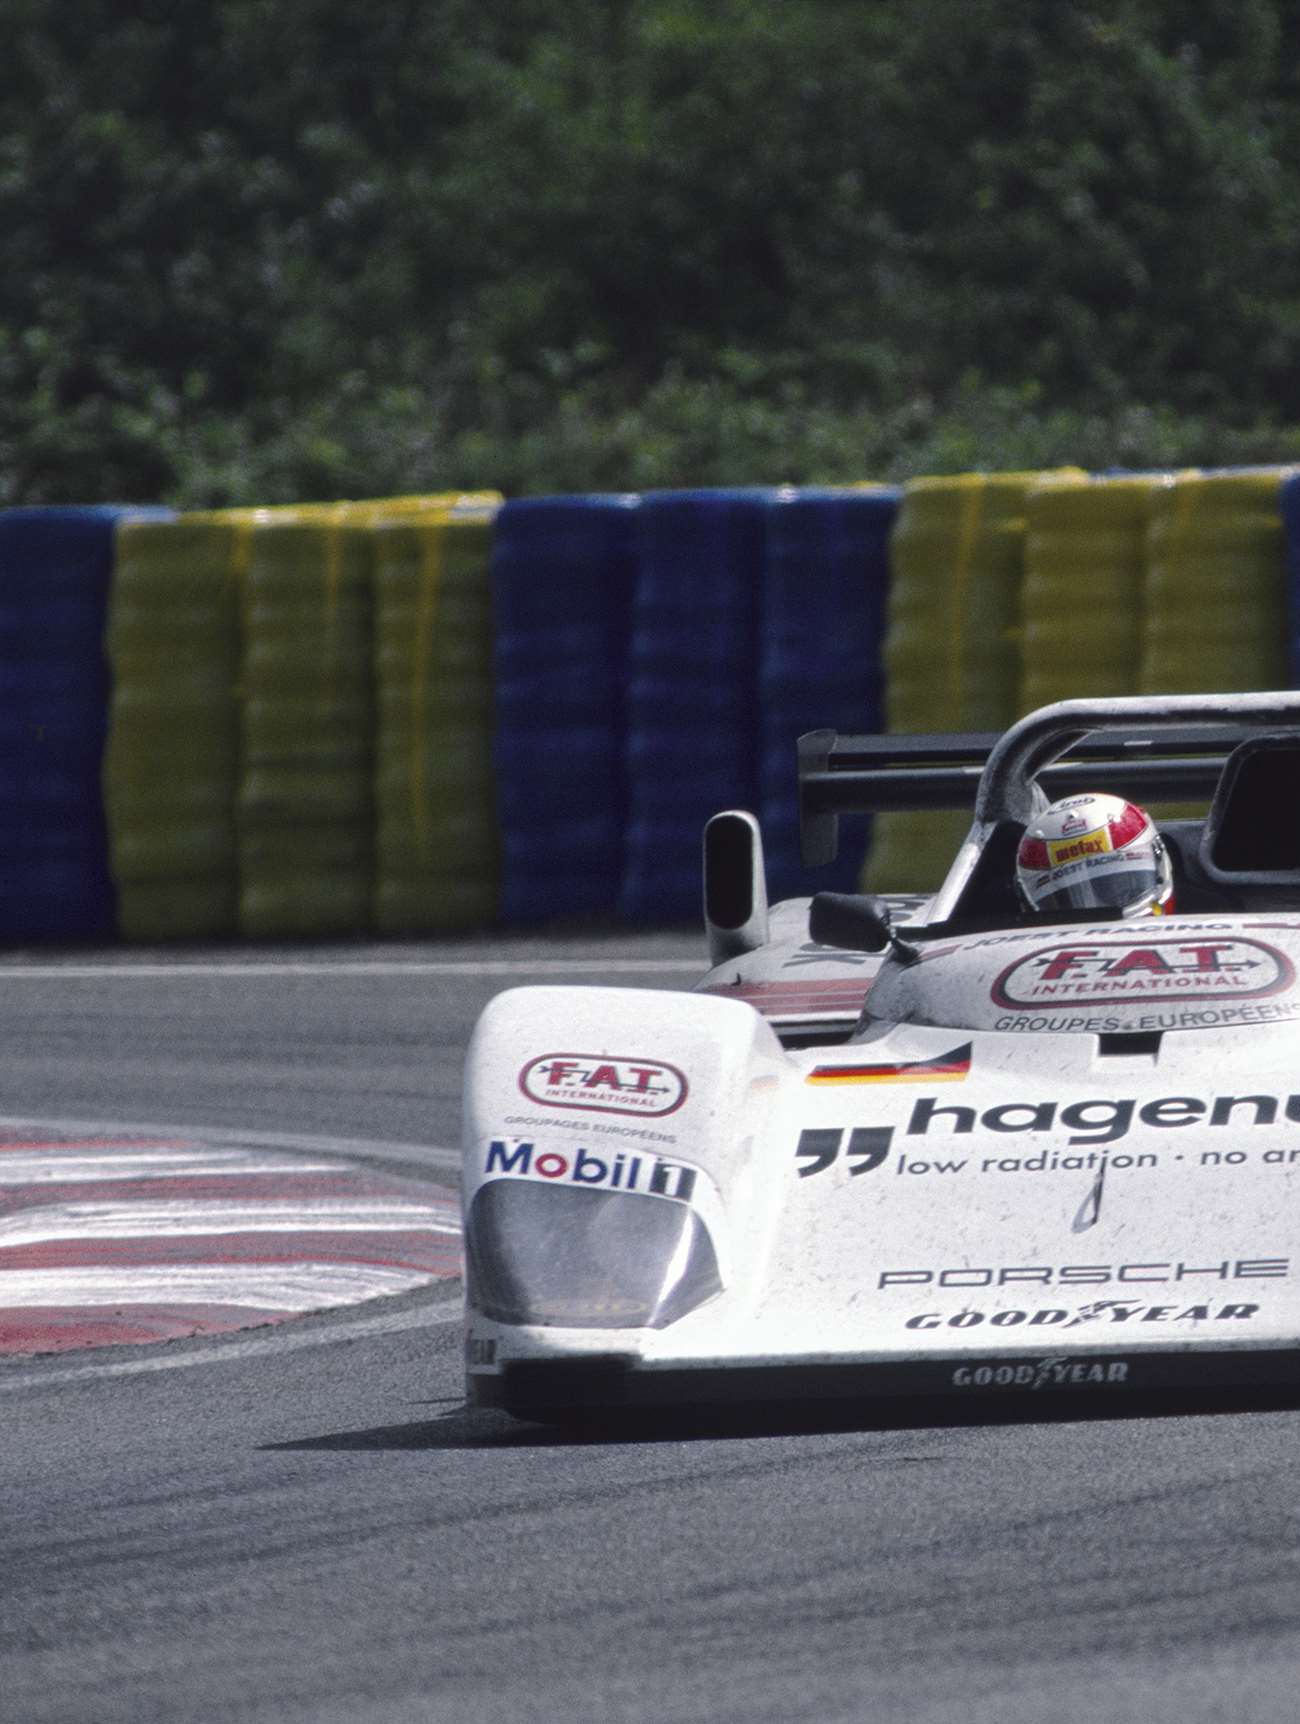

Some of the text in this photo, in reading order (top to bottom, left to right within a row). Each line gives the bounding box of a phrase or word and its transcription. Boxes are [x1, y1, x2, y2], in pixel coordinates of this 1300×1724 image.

[1086, 853, 1125, 868] RACING
[964, 922, 1233, 951] JOEST RACING
[1031, 975, 1248, 996] INTERNATIONAL
[994, 1015, 1119, 1032] GROUPES
[545, 1089, 658, 1108] INTERNATIONAL
[485, 1140, 642, 1189] Mobil
[896, 1154, 968, 1176] low
[981, 1150, 1158, 1173] radiation
[1200, 1150, 1248, 1166] no
[877, 1258, 1291, 1290] PORSCHE
